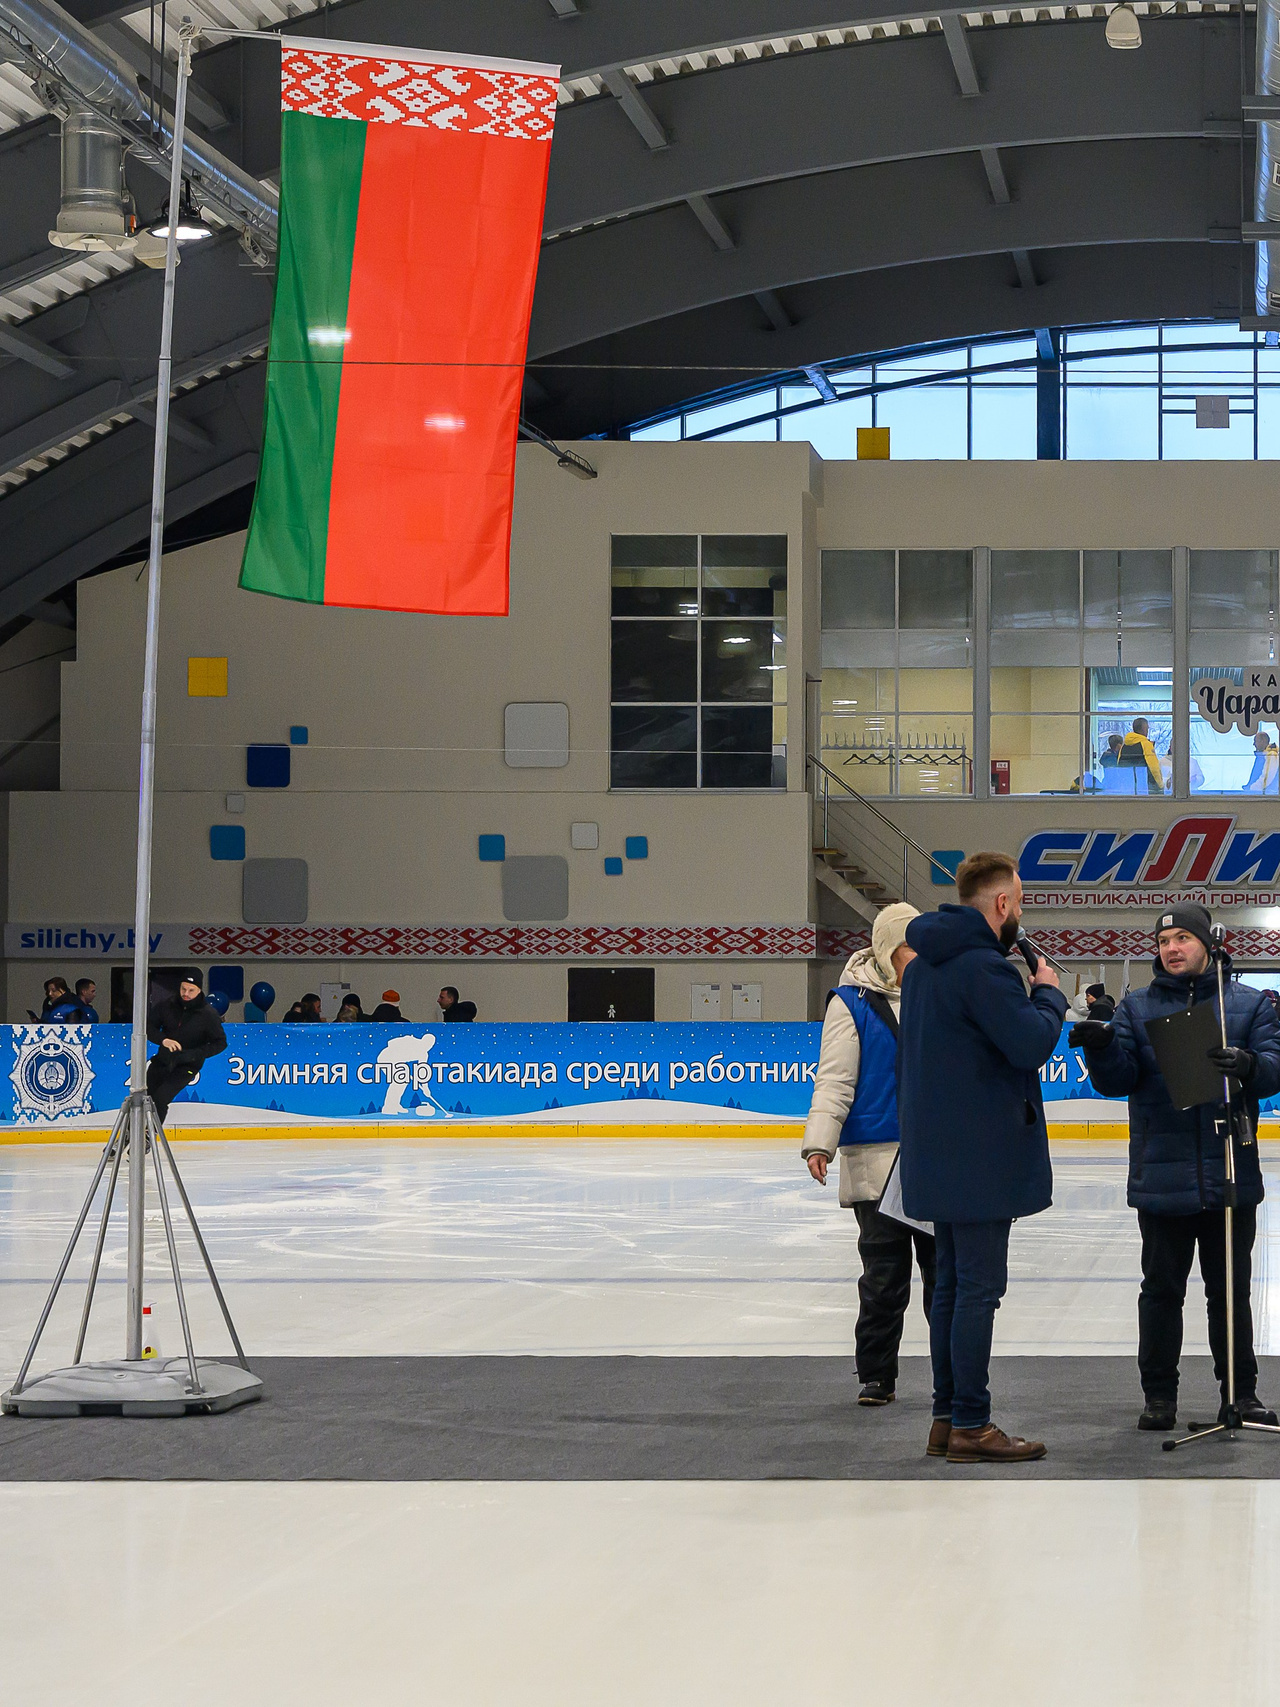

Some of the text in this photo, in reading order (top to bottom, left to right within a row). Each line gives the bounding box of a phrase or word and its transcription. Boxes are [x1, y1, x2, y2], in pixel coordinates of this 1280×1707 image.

[1022, 890, 1207, 905] ЕСПУБЛИКАНСКИЙ
[227, 1056, 348, 1085] Зимняя
[357, 1061, 558, 1091] спартакиада
[566, 1061, 660, 1090] среди
[669, 1053, 819, 1090] работник
